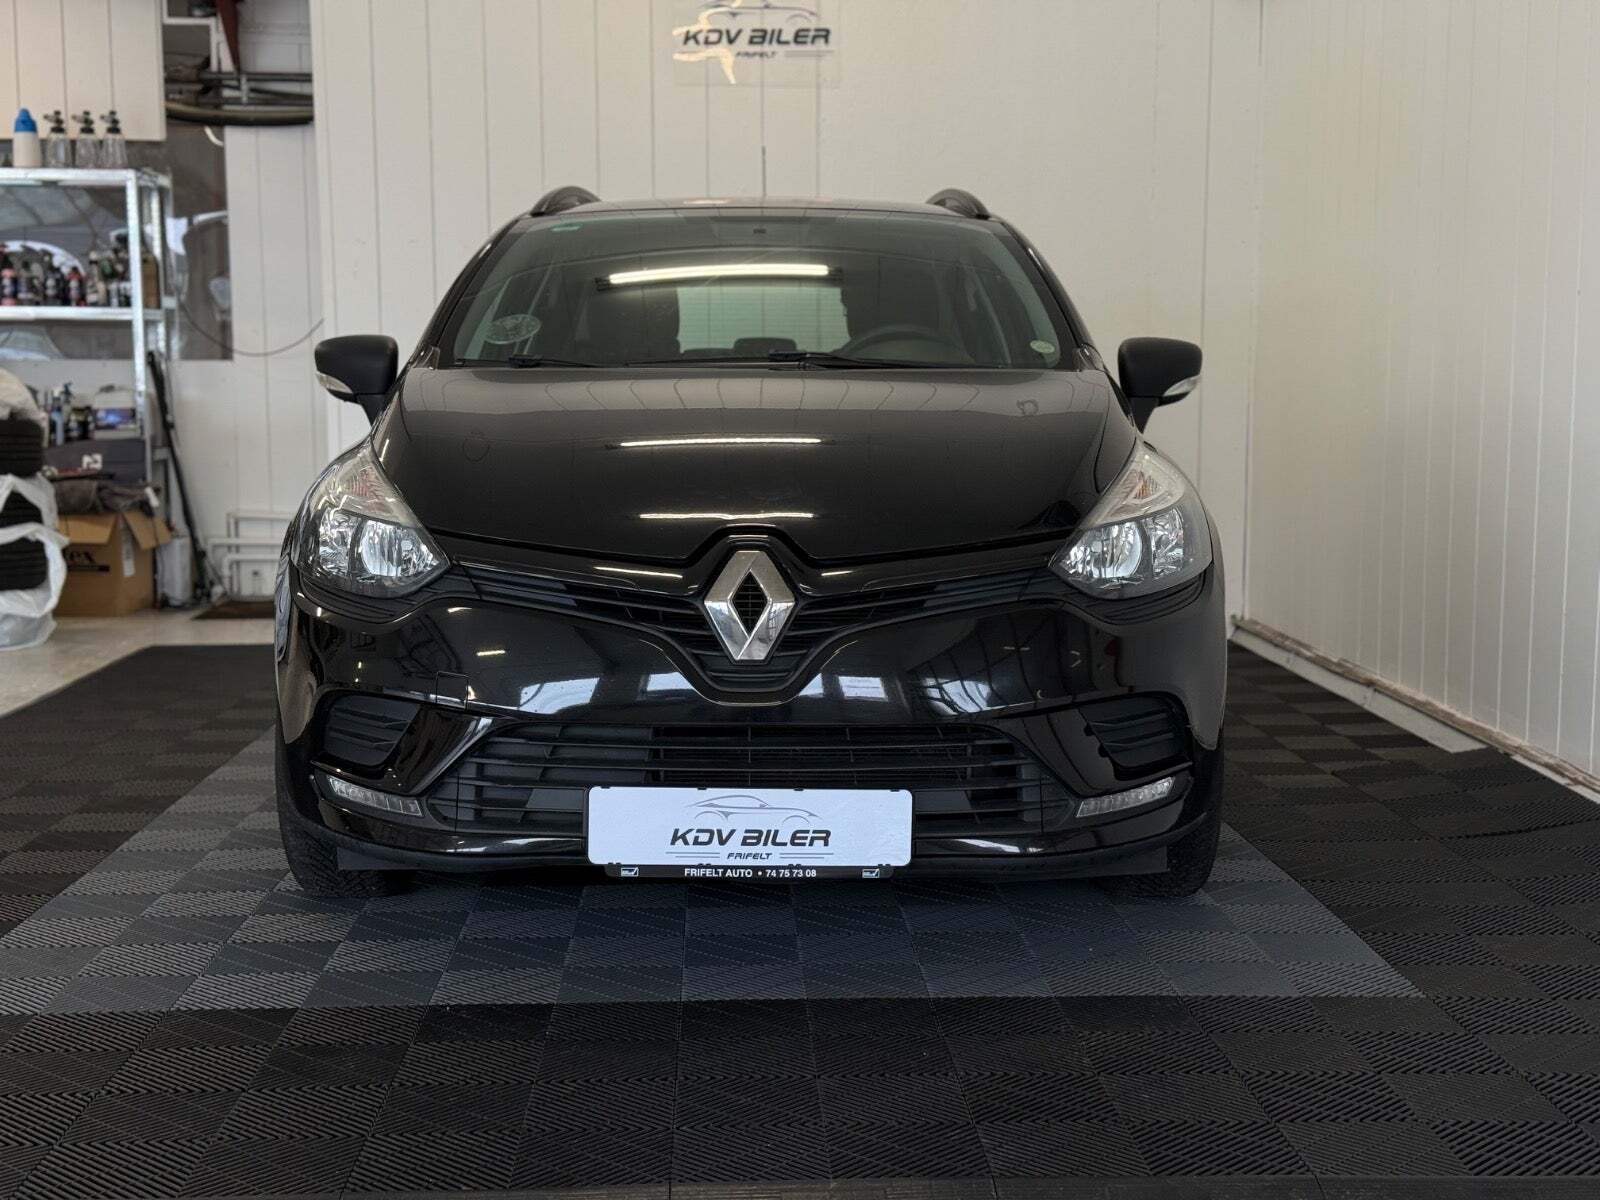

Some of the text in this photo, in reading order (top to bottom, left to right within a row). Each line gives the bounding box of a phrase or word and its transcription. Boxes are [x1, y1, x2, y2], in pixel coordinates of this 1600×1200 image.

[683, 28, 830, 45] KDV BILER
[670, 828, 831, 847] KDV BILER
[727, 852, 772, 860] FRIFELT
[684, 868, 817, 878] FRIFELT AUTO 74 75 73 08
